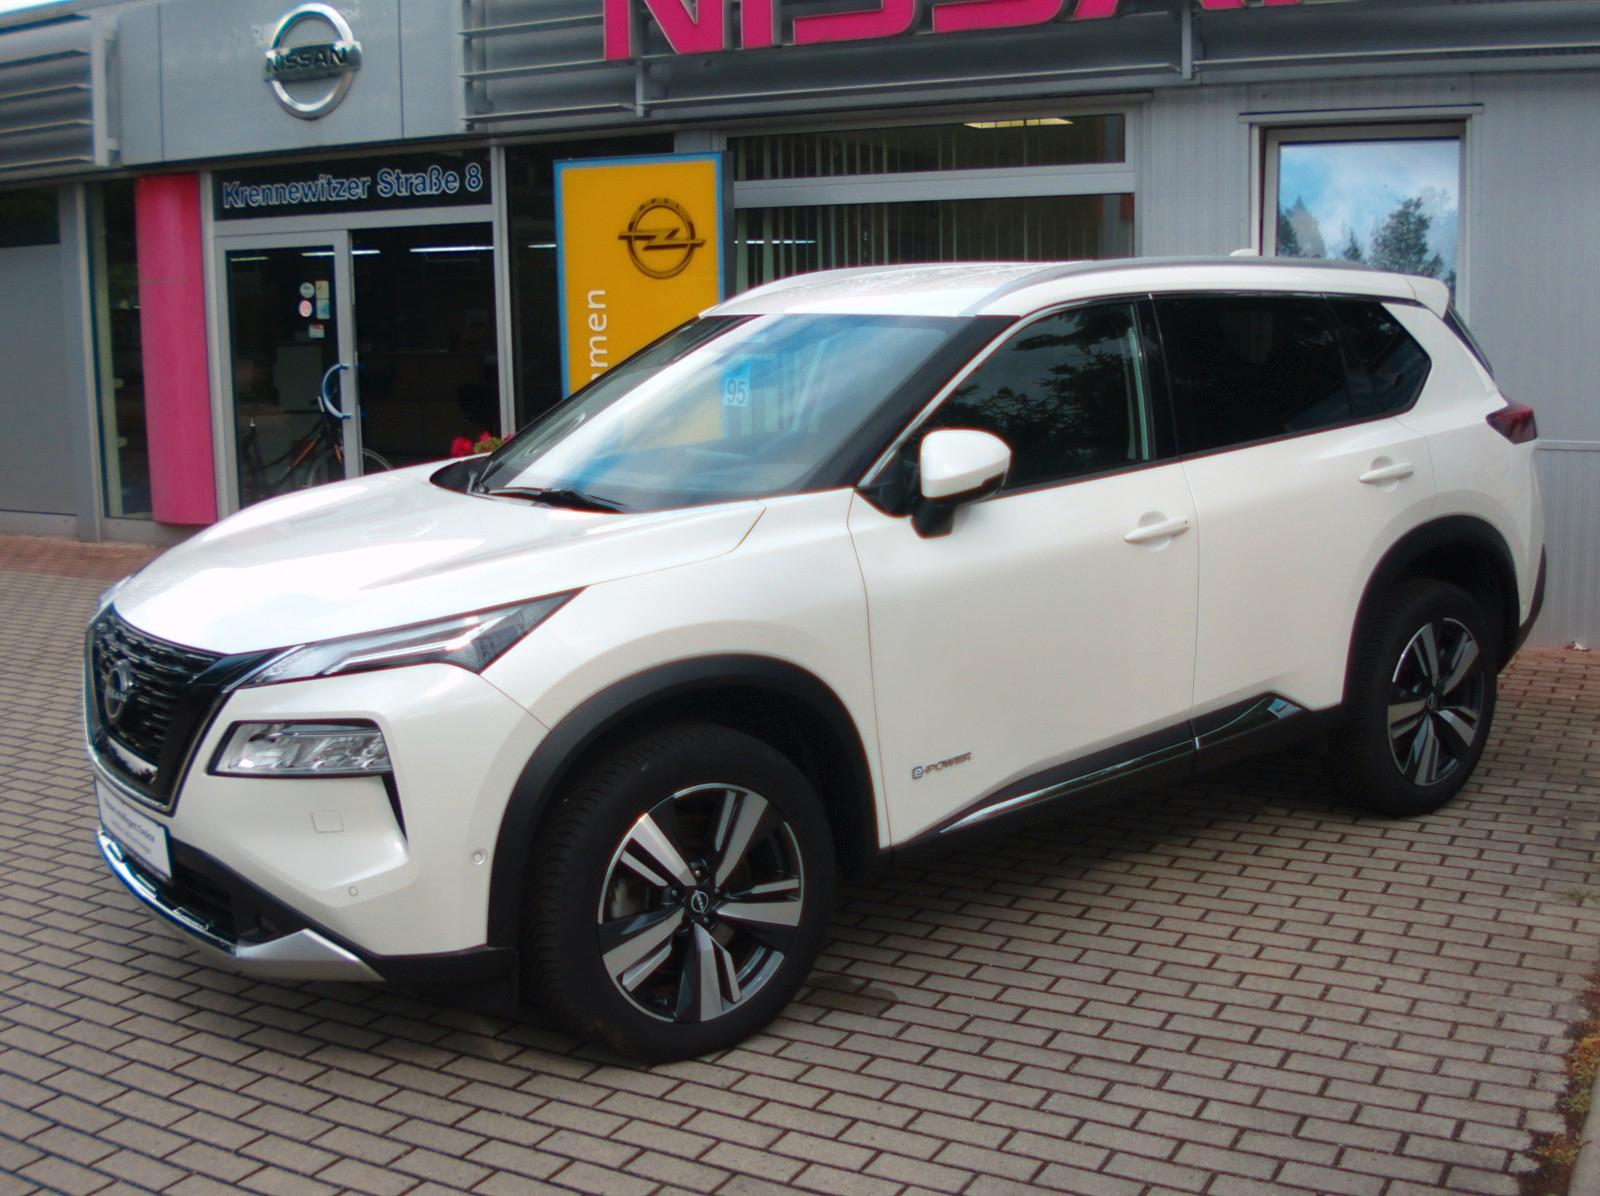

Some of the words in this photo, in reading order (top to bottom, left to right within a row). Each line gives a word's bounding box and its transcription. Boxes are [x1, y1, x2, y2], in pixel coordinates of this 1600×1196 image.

[223, 174, 372, 208] Krennewitzer
[377, 165, 460, 198] Straße
[465, 163, 482, 193] 8
[586, 289, 609, 382] men
